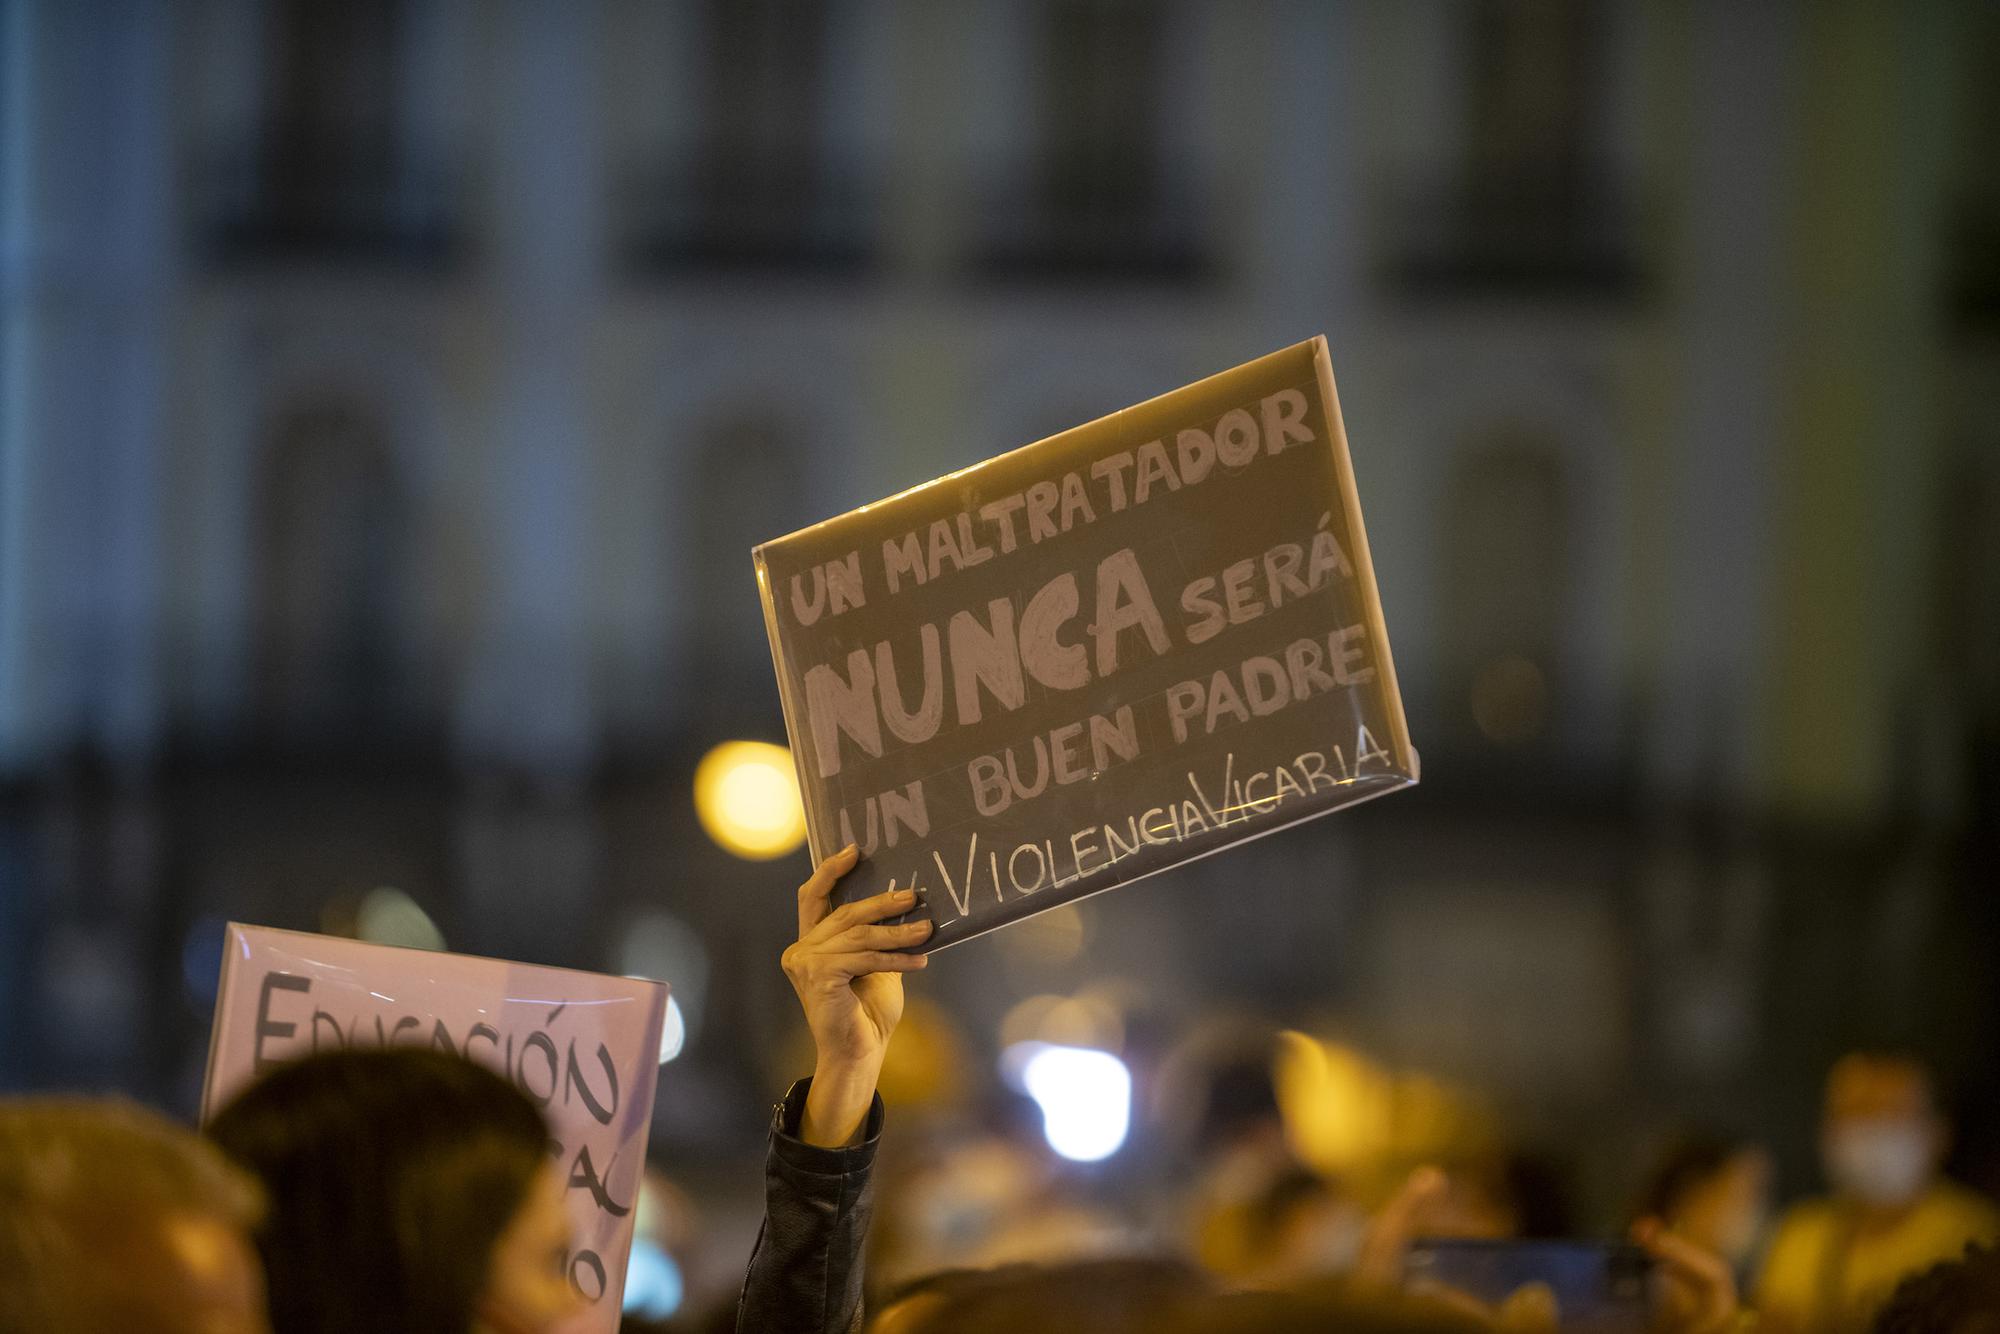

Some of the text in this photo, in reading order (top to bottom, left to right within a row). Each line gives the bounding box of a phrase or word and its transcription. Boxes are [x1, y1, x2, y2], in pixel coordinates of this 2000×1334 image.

[790, 389, 1316, 627] UN MALTRATADOR
[804, 511, 1352, 778] NUNCA SERÁ
[839, 623, 1376, 859] UN BUEN PADRE
